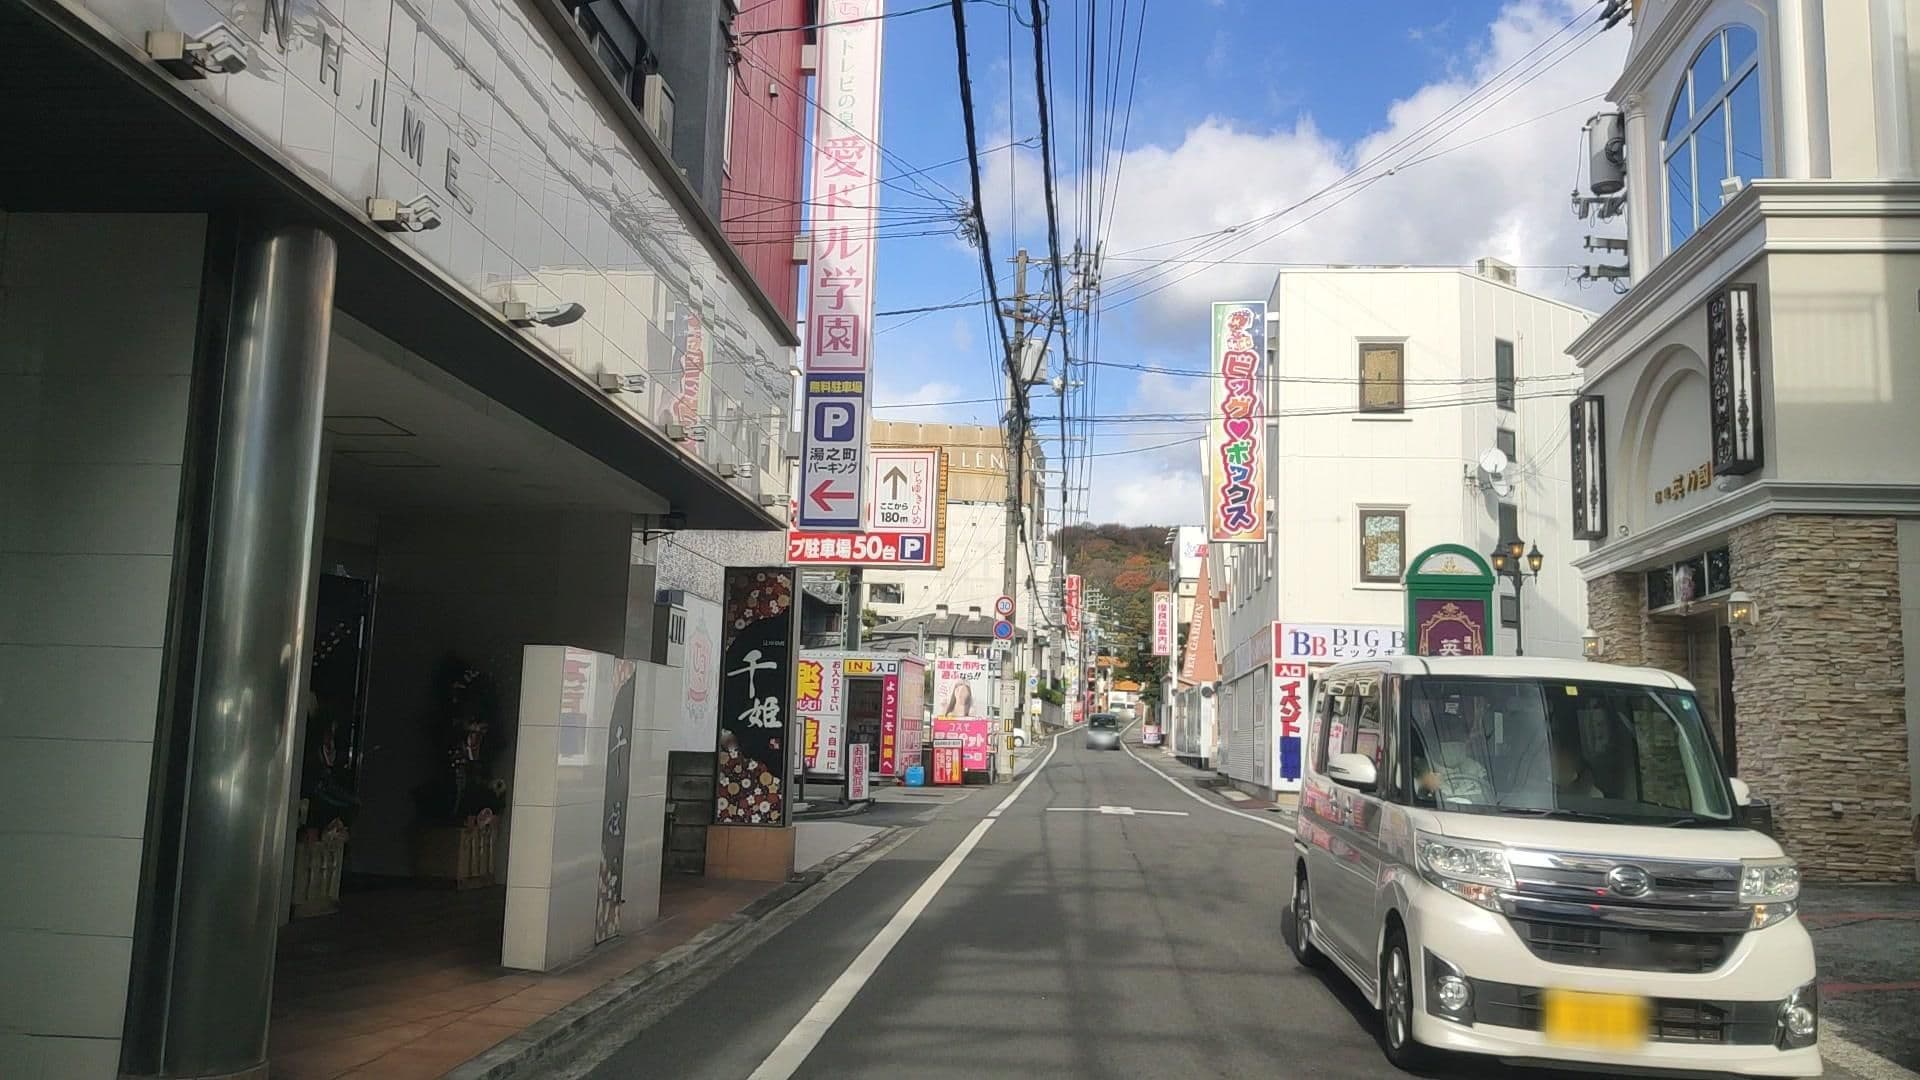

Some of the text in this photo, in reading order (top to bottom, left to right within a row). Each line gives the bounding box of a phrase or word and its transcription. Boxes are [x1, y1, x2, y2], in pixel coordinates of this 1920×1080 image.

[817, 135, 868, 357] 愛ドル学園
[809, 381, 862, 393] 無料駐車場
[823, 406, 849, 438] P
[809, 447, 857, 461] 湯之町
[808, 461, 858, 474] パーキング
[880, 503, 908, 511] ここから
[881, 512, 908, 523] 180m
[904, 538, 921, 559] P
[1000, 602, 1010, 610] 30
[1333, 628, 1379, 647] BIG
[848, 661, 863, 672] IN
[876, 663, 896, 672] 入口
[1280, 666, 1302, 675] 入口
[727, 649, 782, 728] 千姫
[829, 661, 841, 712] お入り下さい
[1280, 681, 1301, 737] イベント
[826, 725, 838, 770] ご自由に
